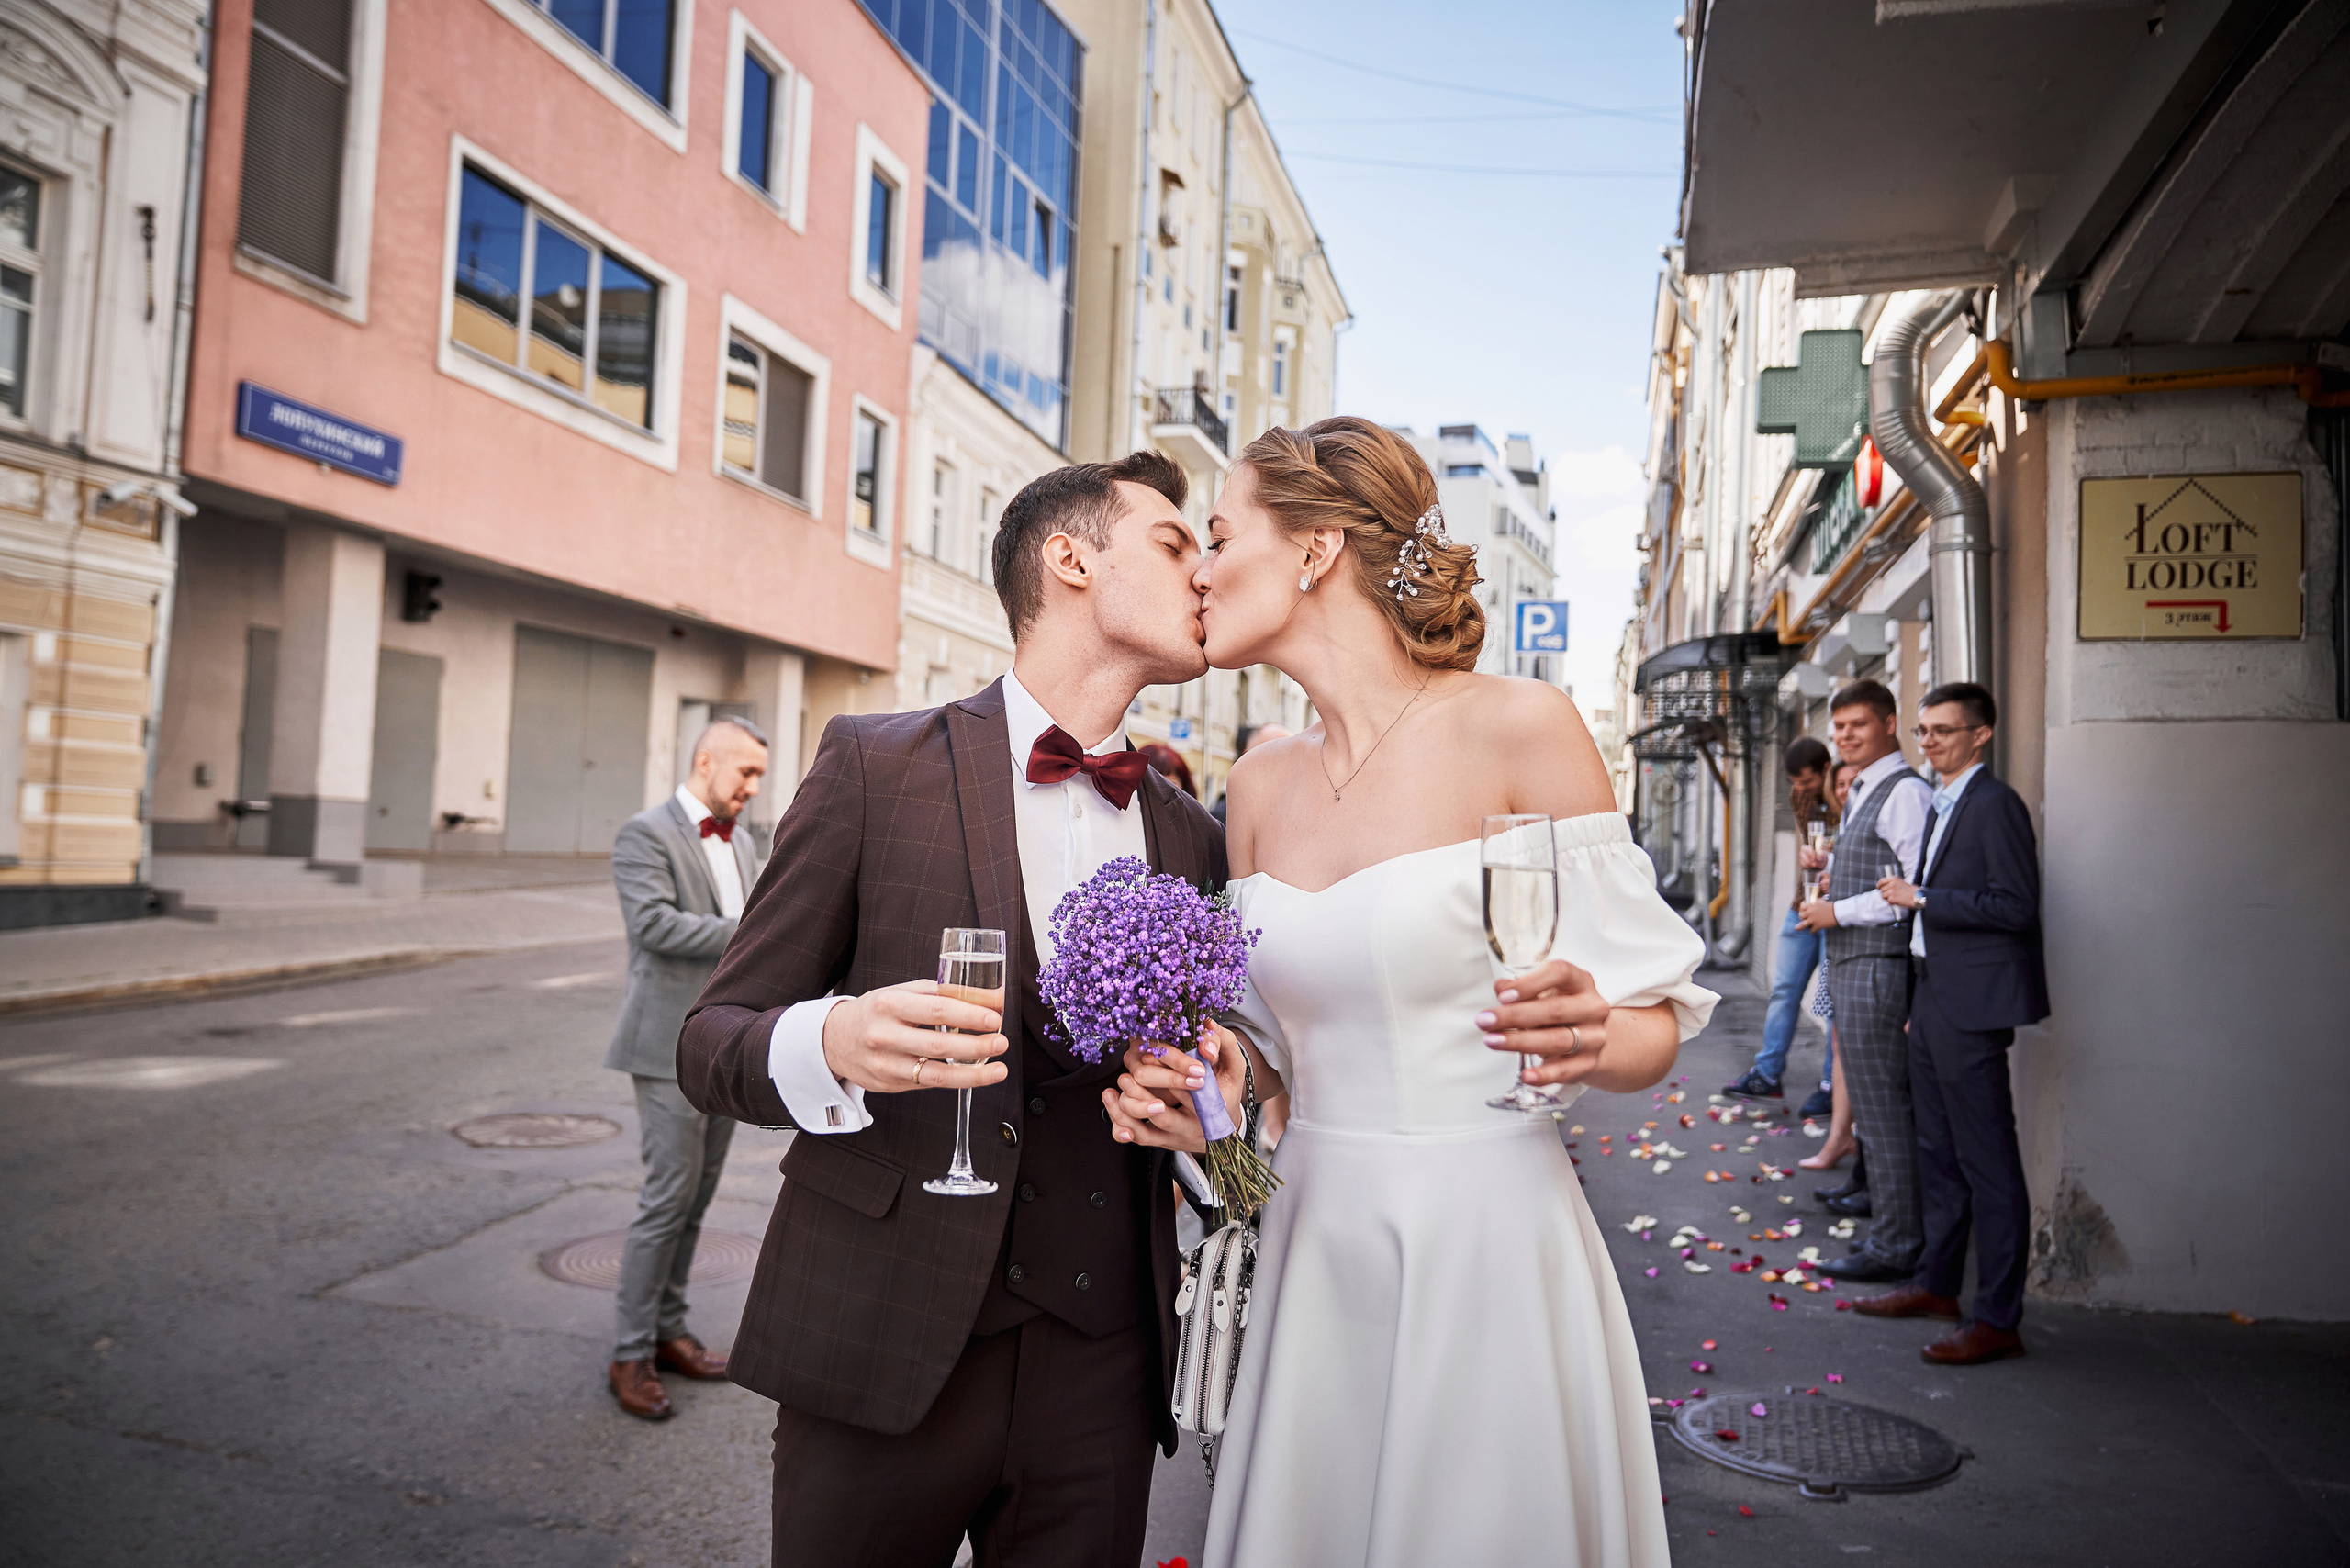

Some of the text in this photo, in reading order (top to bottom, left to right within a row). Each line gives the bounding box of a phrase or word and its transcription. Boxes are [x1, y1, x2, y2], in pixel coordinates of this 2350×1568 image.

[2134, 502, 2243, 554] LOFT
[2125, 559, 2258, 591] LODGE
[1522, 604, 1557, 650] P
[2165, 611, 2174, 625] 3
